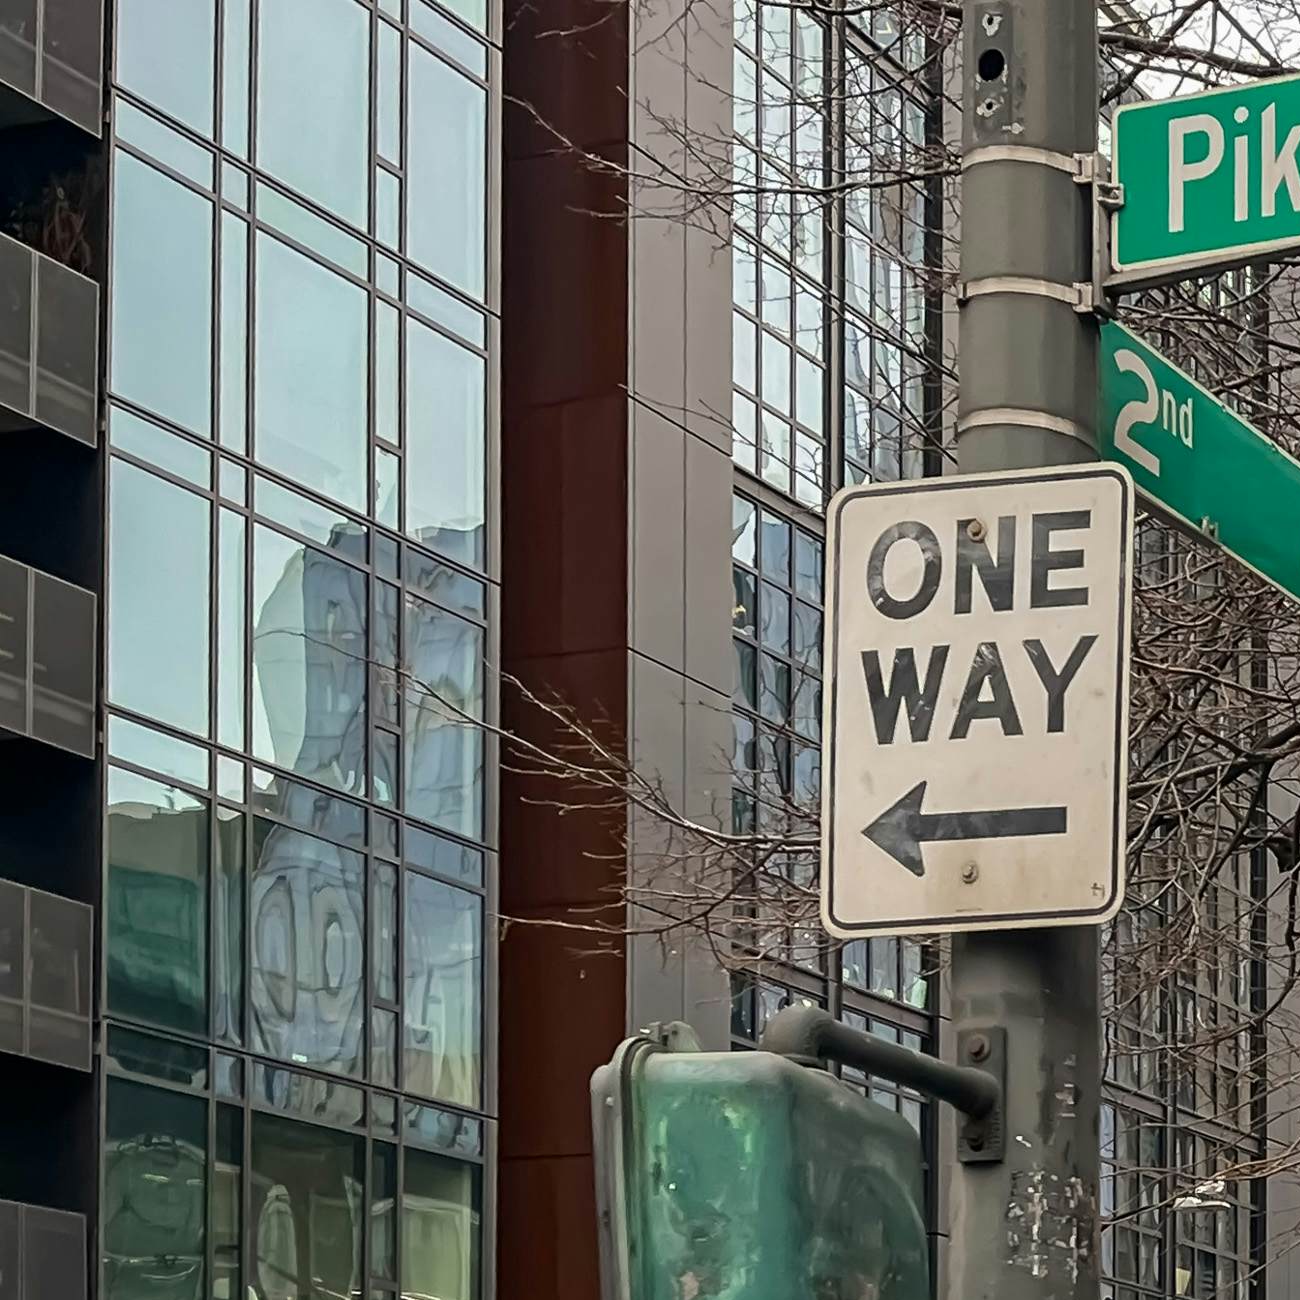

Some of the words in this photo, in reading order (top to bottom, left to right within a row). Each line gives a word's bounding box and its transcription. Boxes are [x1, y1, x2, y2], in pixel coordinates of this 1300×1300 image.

[1112, 348, 1194, 476] 2nd
[866, 510, 1092, 620] ONE
[860, 634, 1100, 745] WAY
